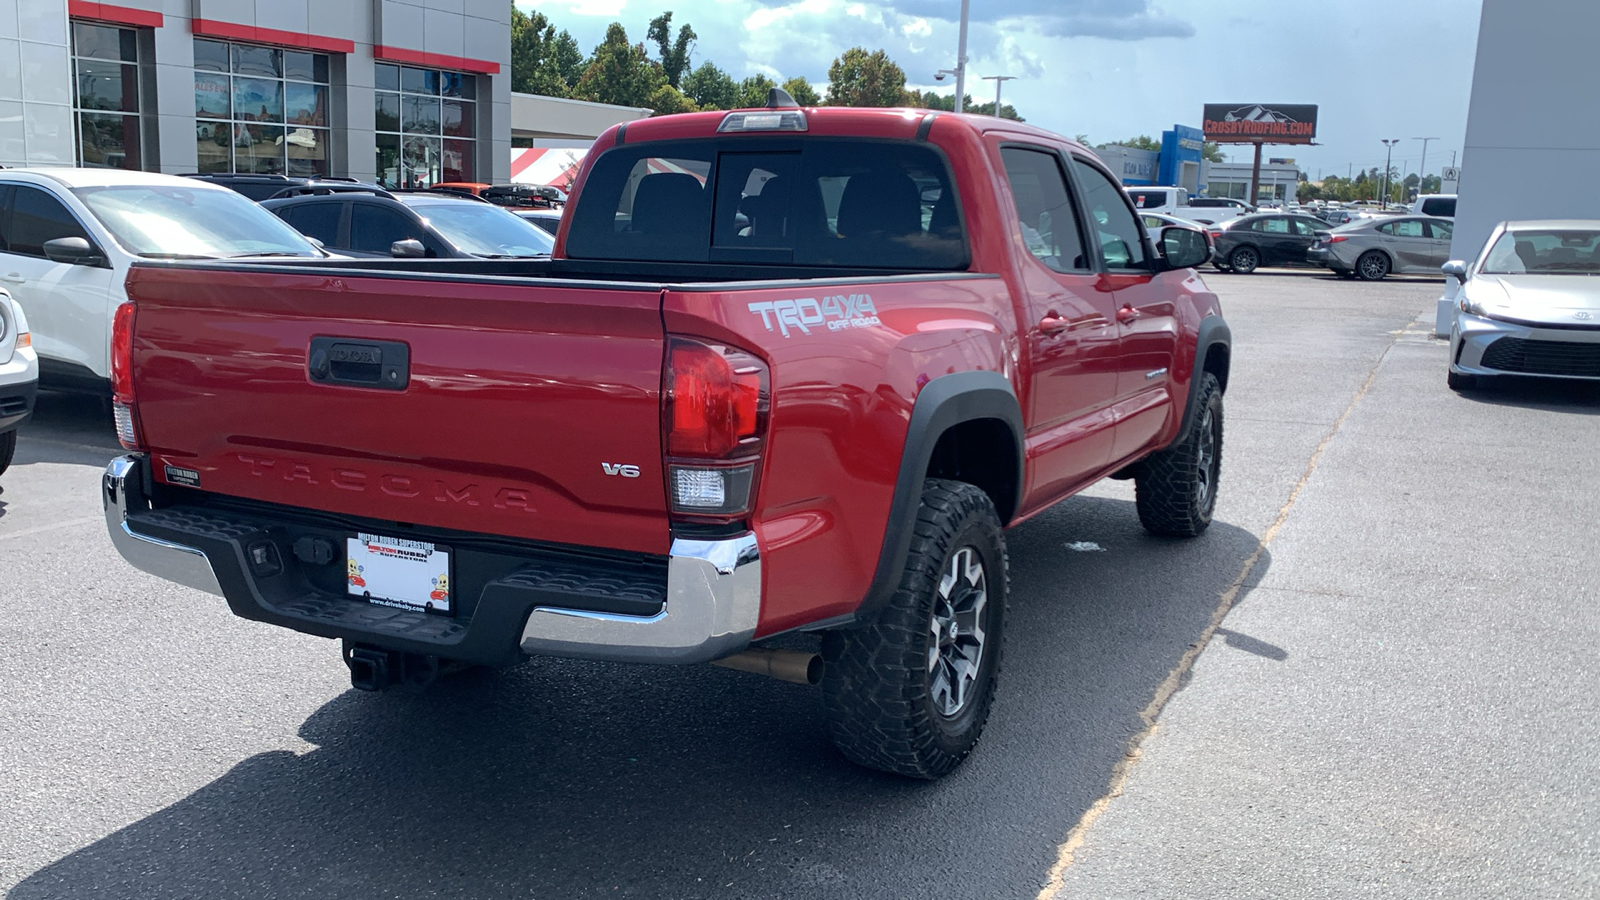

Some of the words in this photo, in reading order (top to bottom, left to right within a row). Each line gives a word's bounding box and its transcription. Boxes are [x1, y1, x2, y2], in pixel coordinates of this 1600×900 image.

[195, 83, 213, 92] ALES
[748, 298, 825, 338] TRD
[821, 294, 877, 319] 4X4
[827, 319, 850, 332] OFF
[851, 316, 882, 328] ROAD
[333, 349, 376, 362] TOYOTA
[601, 461, 640, 478] V6
[237, 454, 538, 513] TACOMA
[358, 532, 378, 542] MILTON
[379, 535, 398, 545] RUBEN
[399, 538, 435, 550] SUPERSTORE
[368, 545, 397, 553] MILTON
[397, 550, 427, 558] RUBEN
[380, 552, 427, 563] SUPERSTORE
[369, 598, 425, 613] www.drivebaby.com
